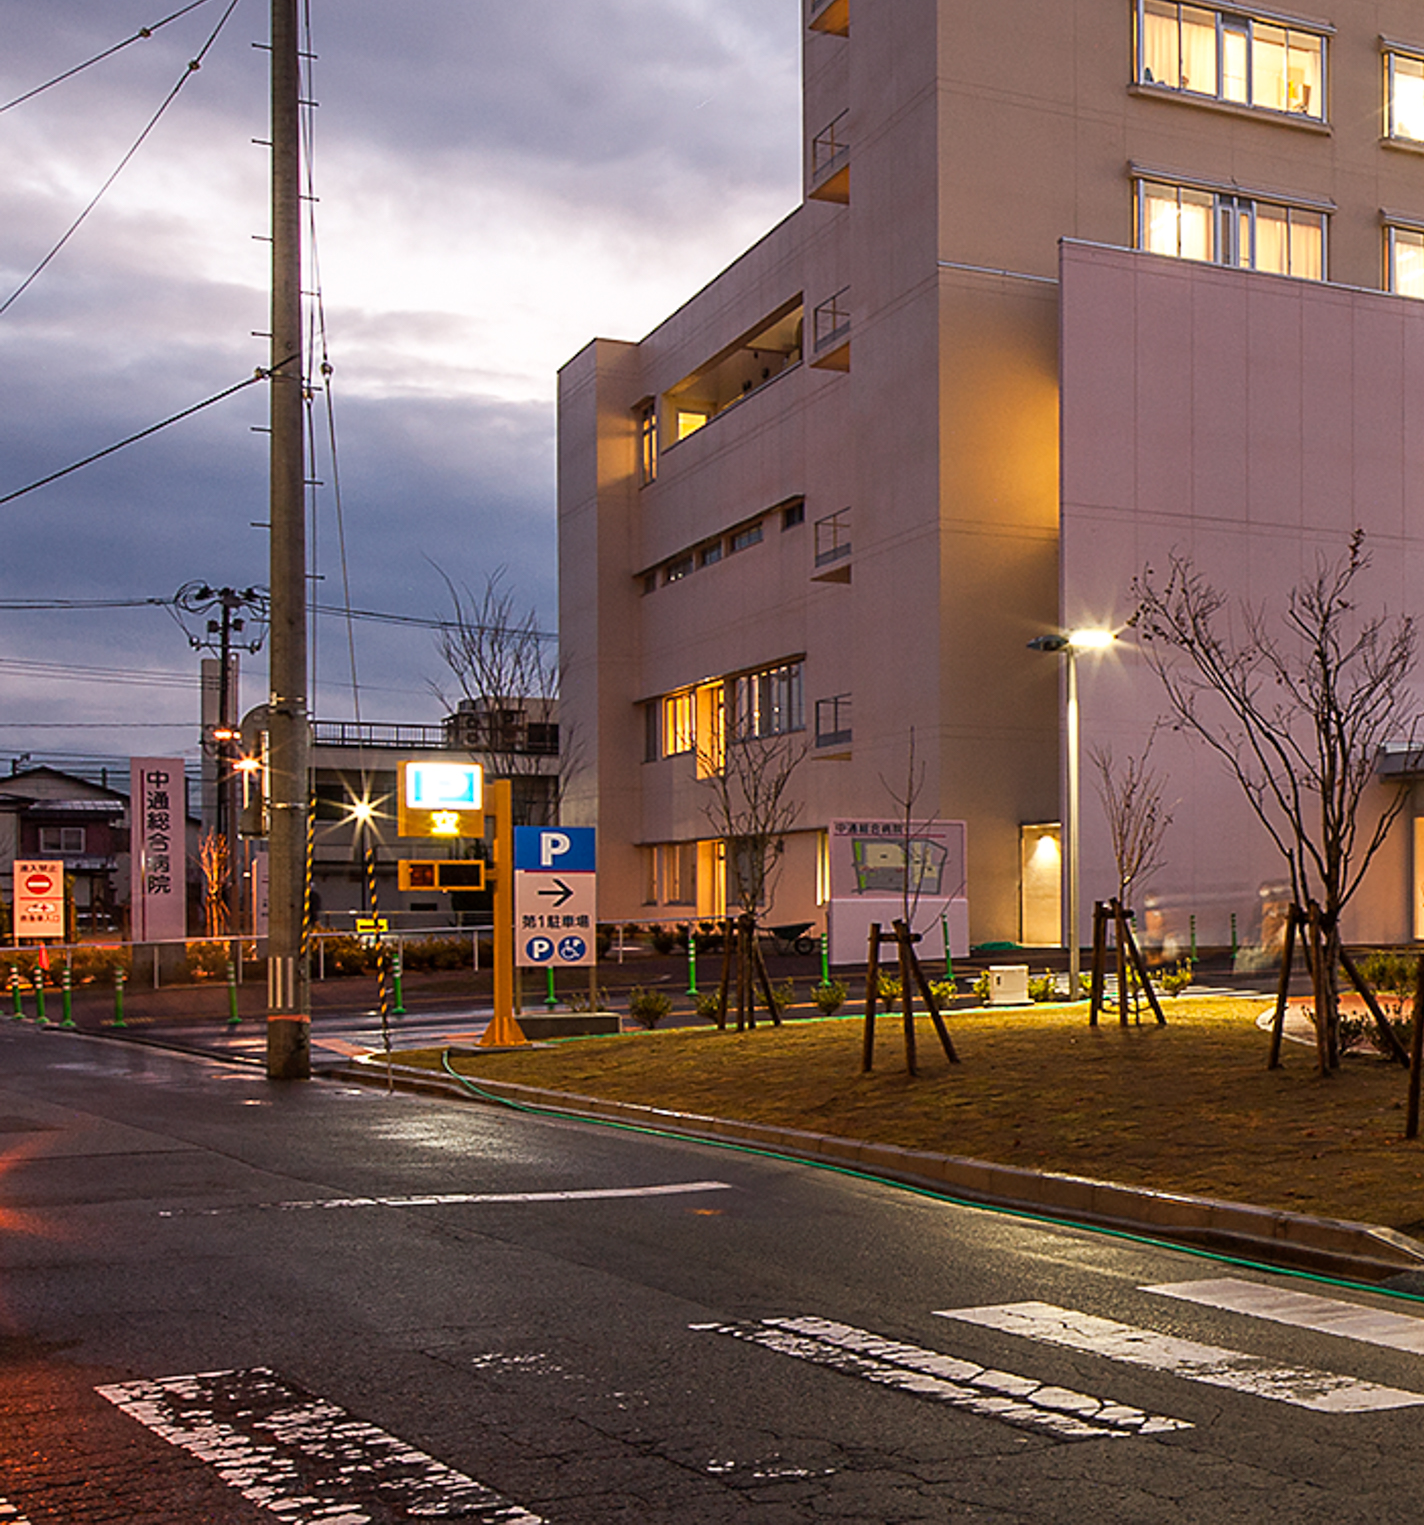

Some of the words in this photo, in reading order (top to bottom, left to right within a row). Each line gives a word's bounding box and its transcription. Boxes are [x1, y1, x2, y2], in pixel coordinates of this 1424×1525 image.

[146, 769, 172, 896] 中通総合病院
[540, 832, 571, 867] P
